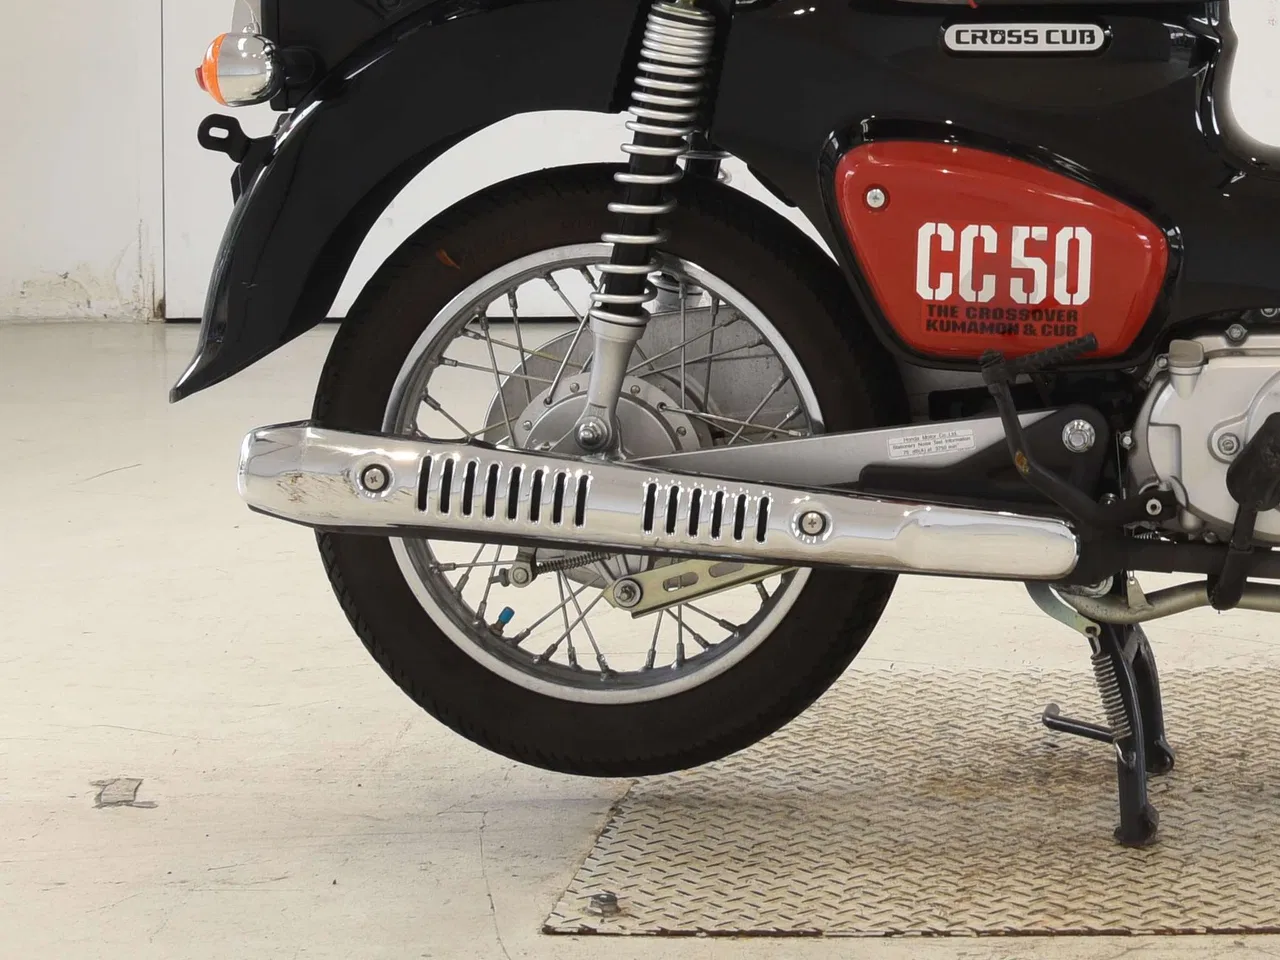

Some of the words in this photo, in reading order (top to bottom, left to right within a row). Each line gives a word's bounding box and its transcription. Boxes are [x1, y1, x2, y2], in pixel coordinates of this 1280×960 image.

[955, 29, 1039, 45] CROSS
[1045, 29, 1096, 45] CUB
[927, 304, 959, 318] THE
[965, 306, 1078, 322] CROSSOVER
[926, 319, 1019, 336] KUMAMON
[1023, 324, 1037, 336] &
[1041, 324, 1078, 337] CUB
